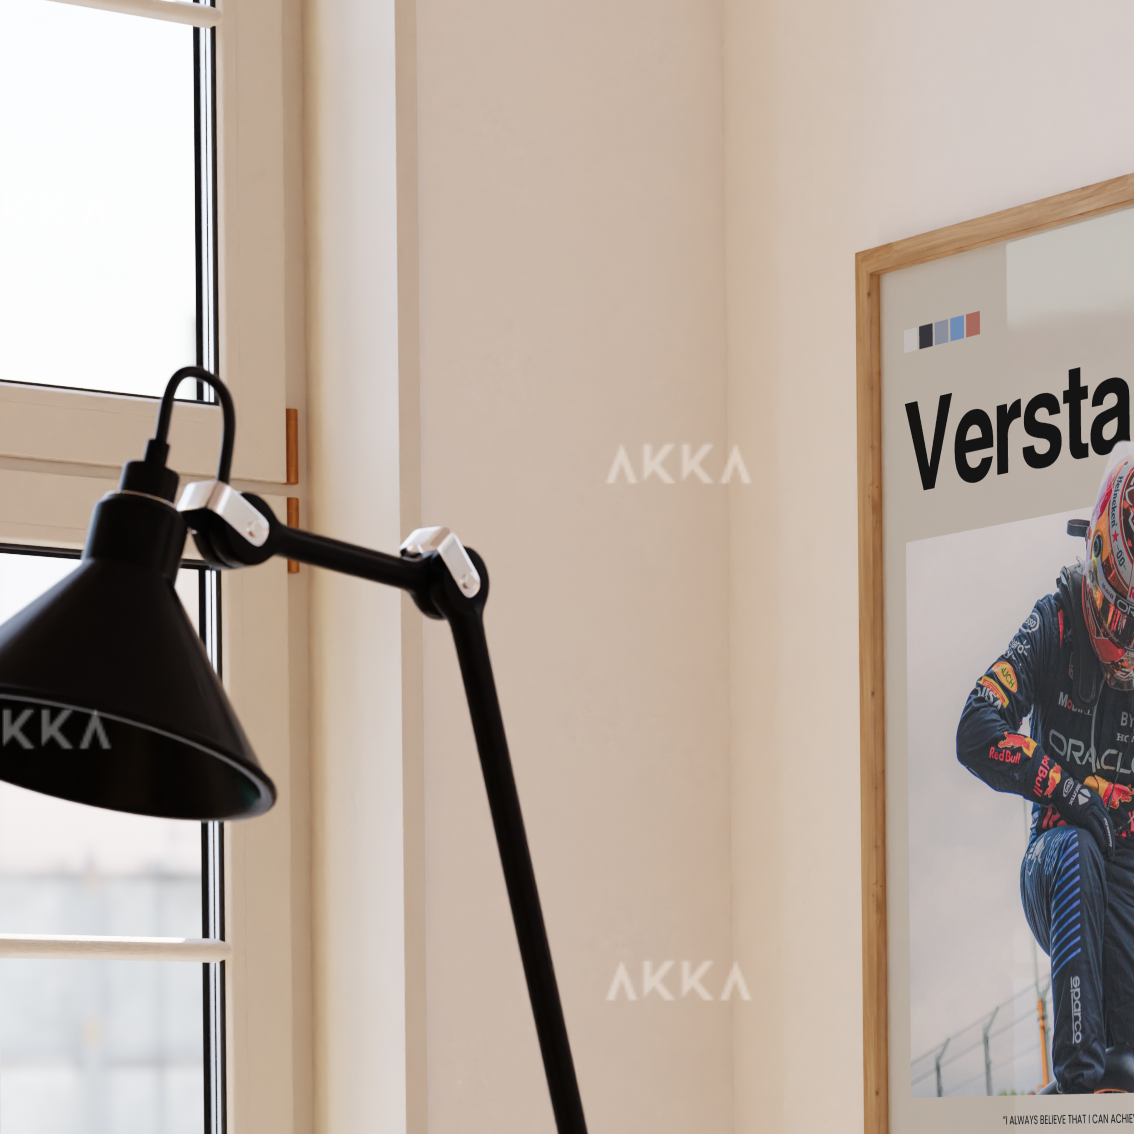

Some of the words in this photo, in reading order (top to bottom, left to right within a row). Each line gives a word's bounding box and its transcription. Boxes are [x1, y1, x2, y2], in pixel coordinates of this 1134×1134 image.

[989, 747, 1004, 760] Red
[1005, 752, 1021, 764] Bull
[1033, 768, 1048, 797] Bull
[1070, 975, 1082, 1044] sparco
[1009, 1115, 1038, 1125] ALWAYS
[1040, 1115, 1066, 1124] BELIEVE
[1068, 1114, 1086, 1124] THAT
[1088, 1115, 1090, 1123] I
[1092, 1114, 1108, 1124] CAN
